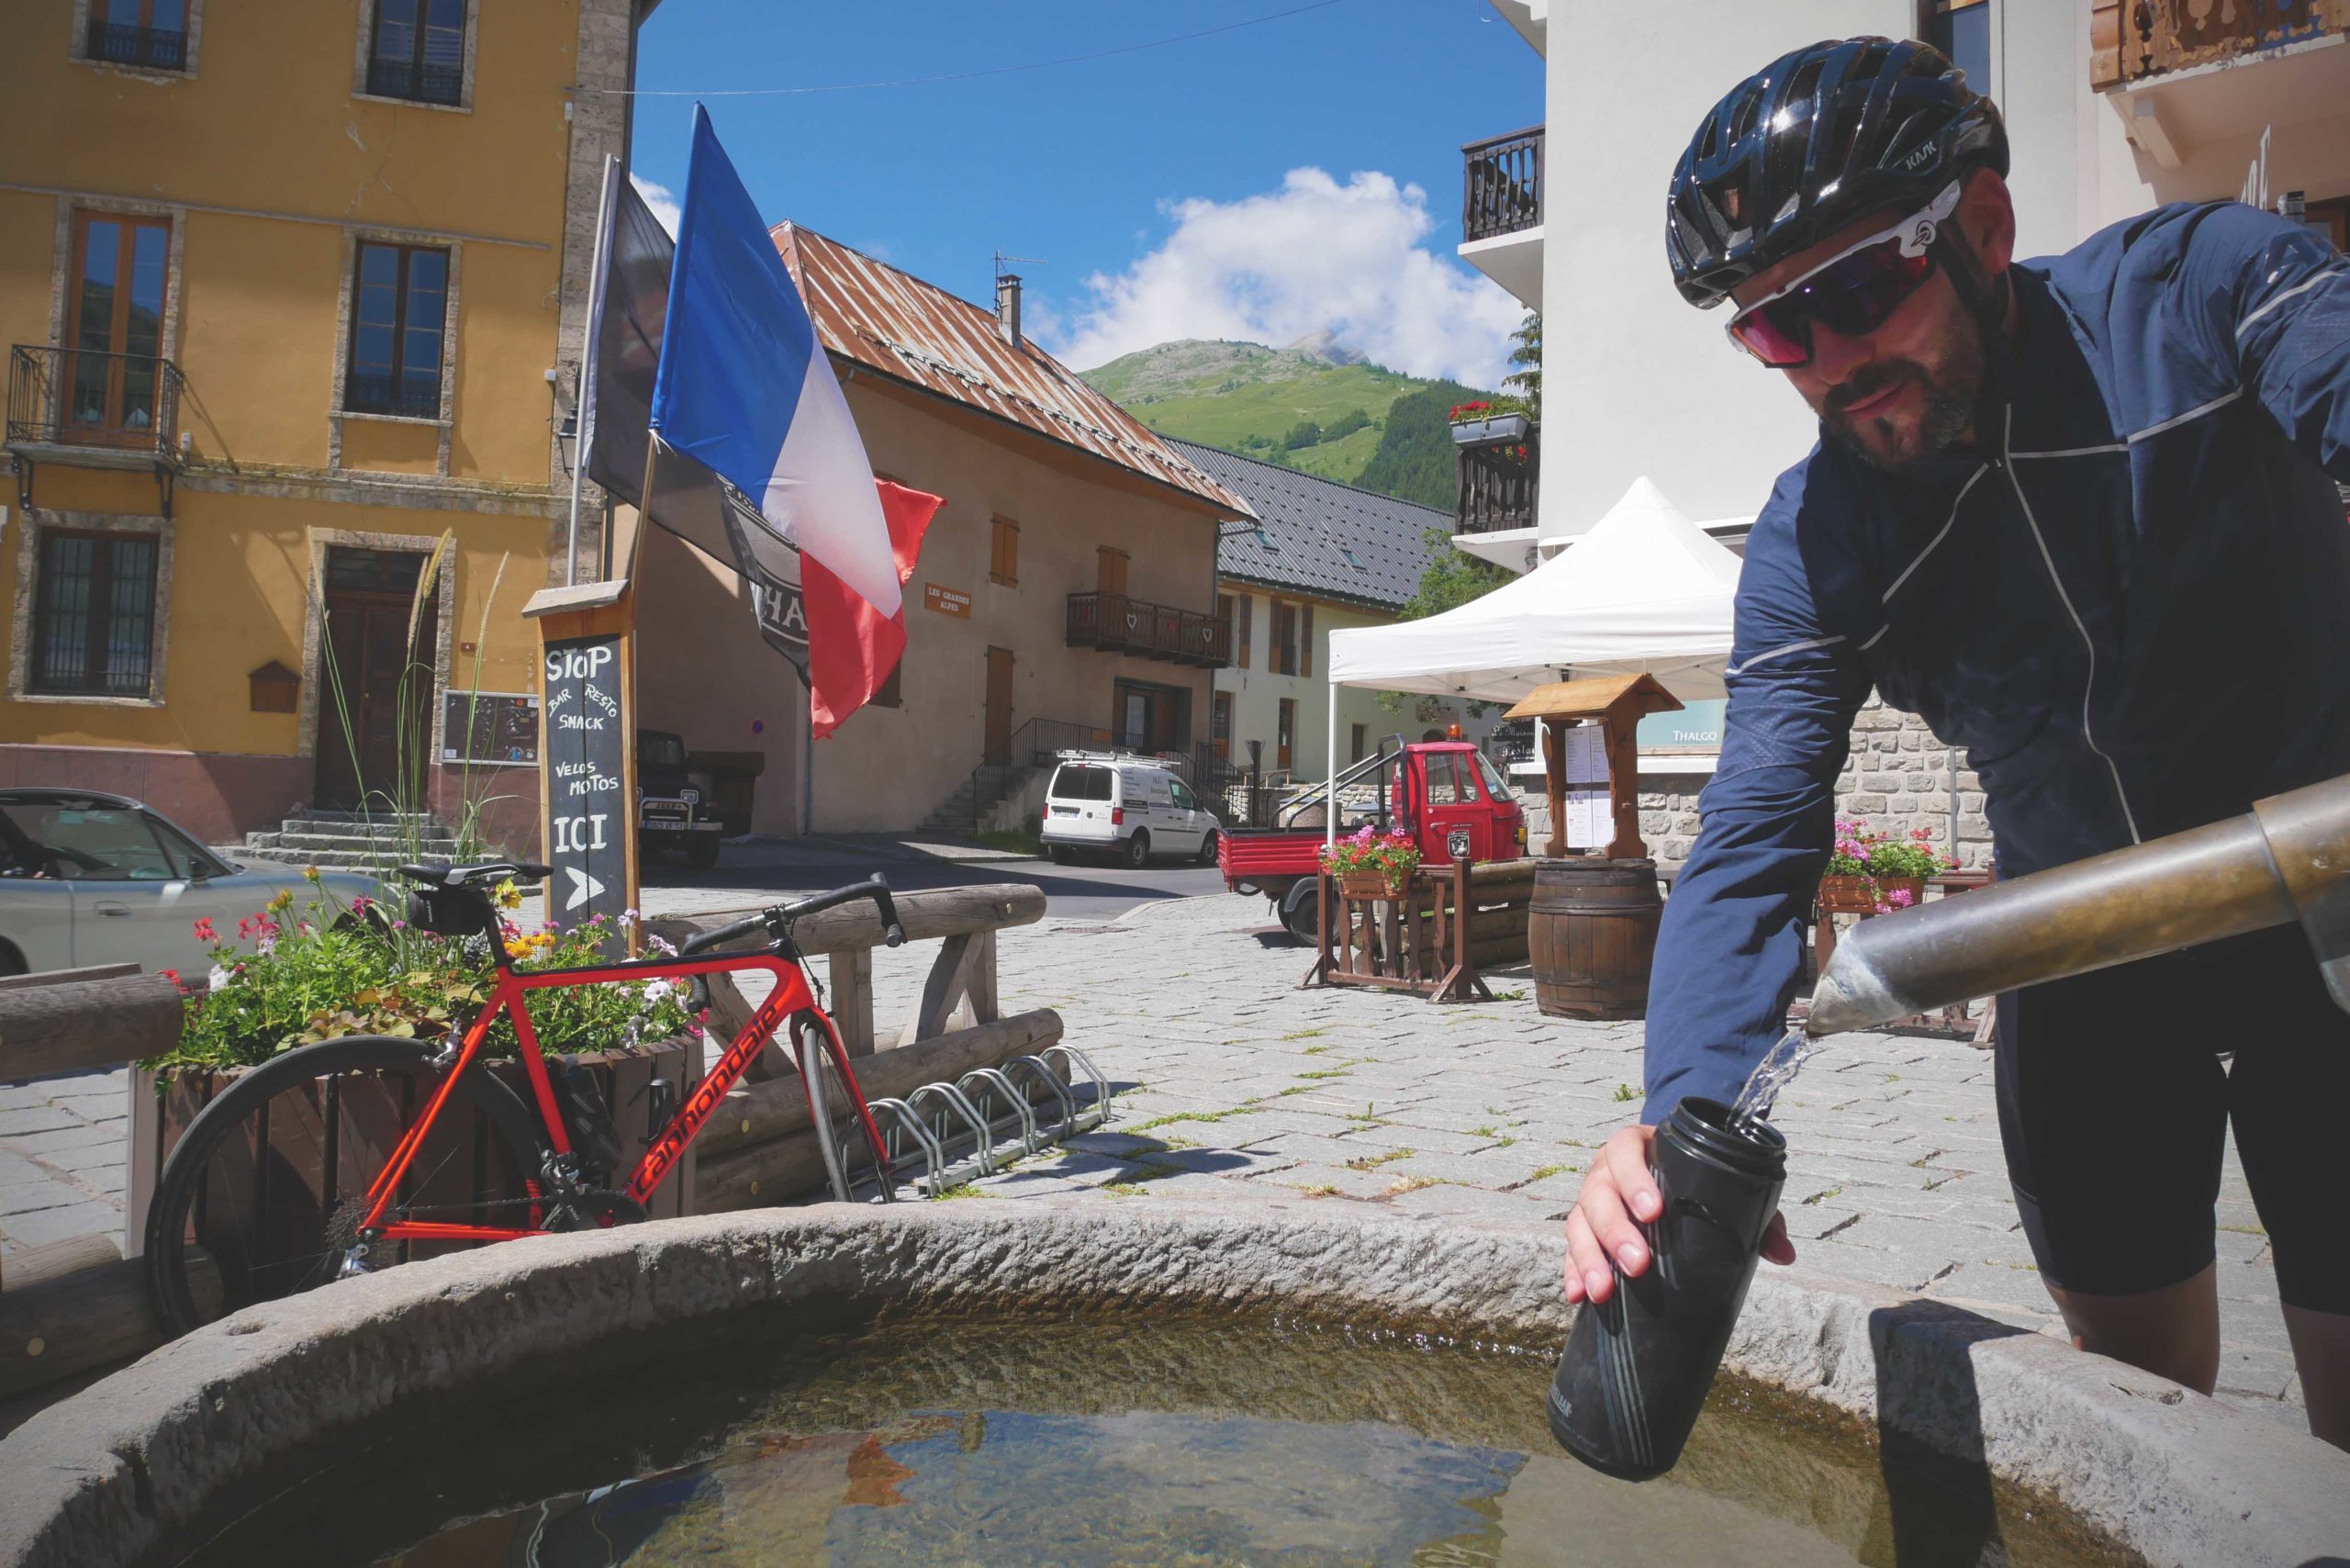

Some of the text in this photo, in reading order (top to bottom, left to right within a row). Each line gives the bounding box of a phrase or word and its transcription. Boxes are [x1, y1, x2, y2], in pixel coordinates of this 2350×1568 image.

[1906, 140, 1937, 170] KASK
[928, 588, 970, 605] LES GRANDES
[940, 601, 959, 611] ALPES
[546, 646, 611, 681] STOP
[548, 683, 618, 718] BAR RESTO
[558, 714, 604, 730] SNACK
[555, 761, 596, 778] VELOS
[569, 774, 619, 796] MOTOS
[554, 813, 608, 853] ICI
[635, 1003, 778, 1196] cannondale
